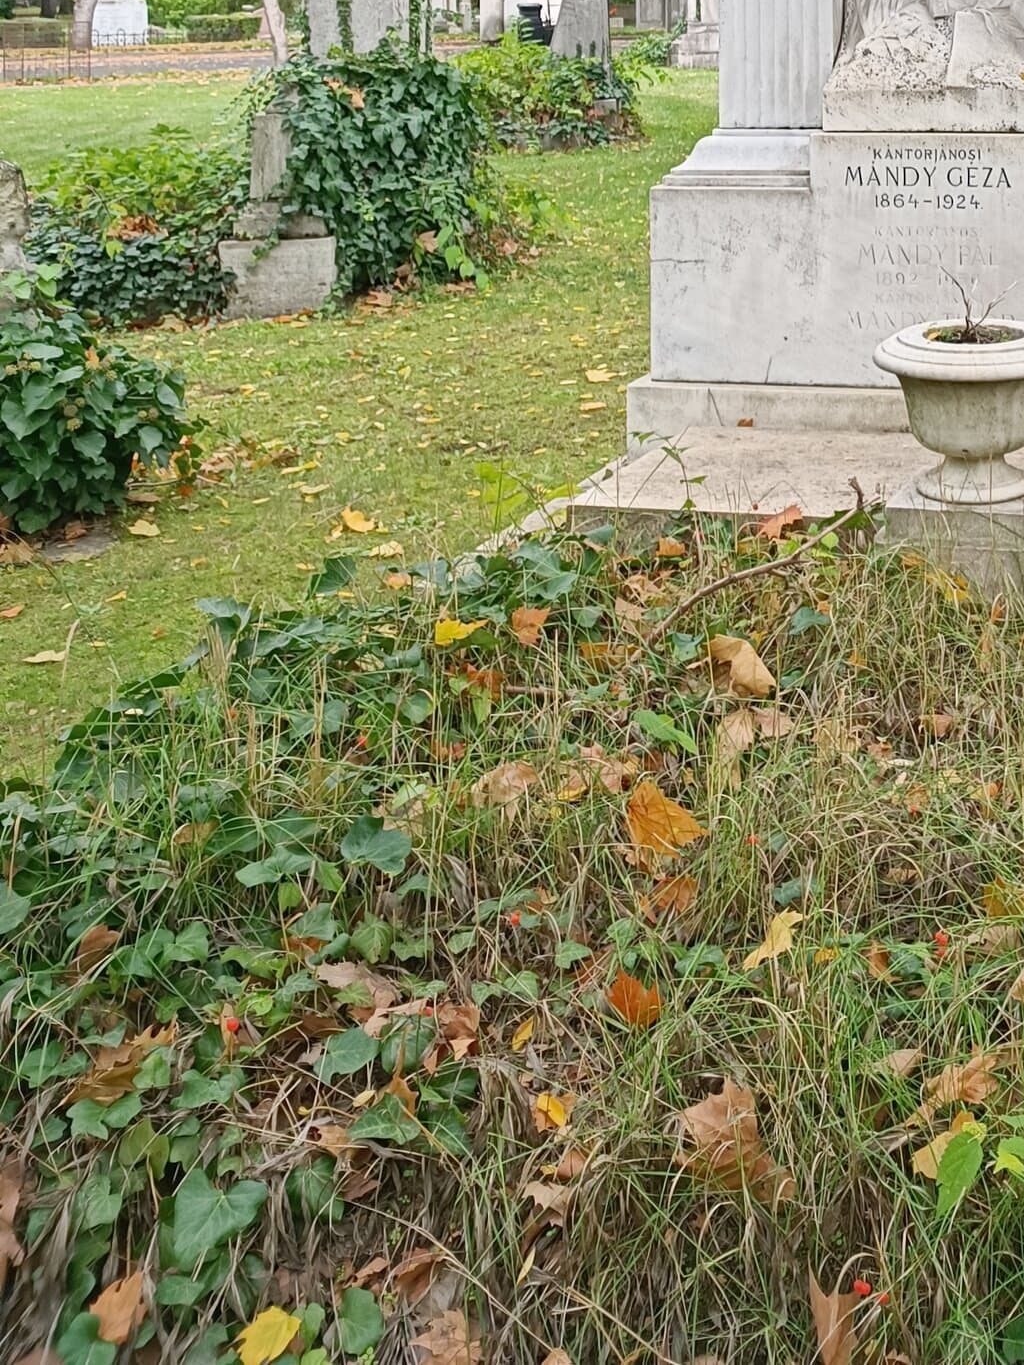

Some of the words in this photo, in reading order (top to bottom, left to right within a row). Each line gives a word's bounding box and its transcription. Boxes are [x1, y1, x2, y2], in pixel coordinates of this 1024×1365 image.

[873, 144, 982, 163] KÁNTORJÁNOSI
[844, 161, 937, 187] MÁNDY
[946, 161, 1012, 188] GÉZA
